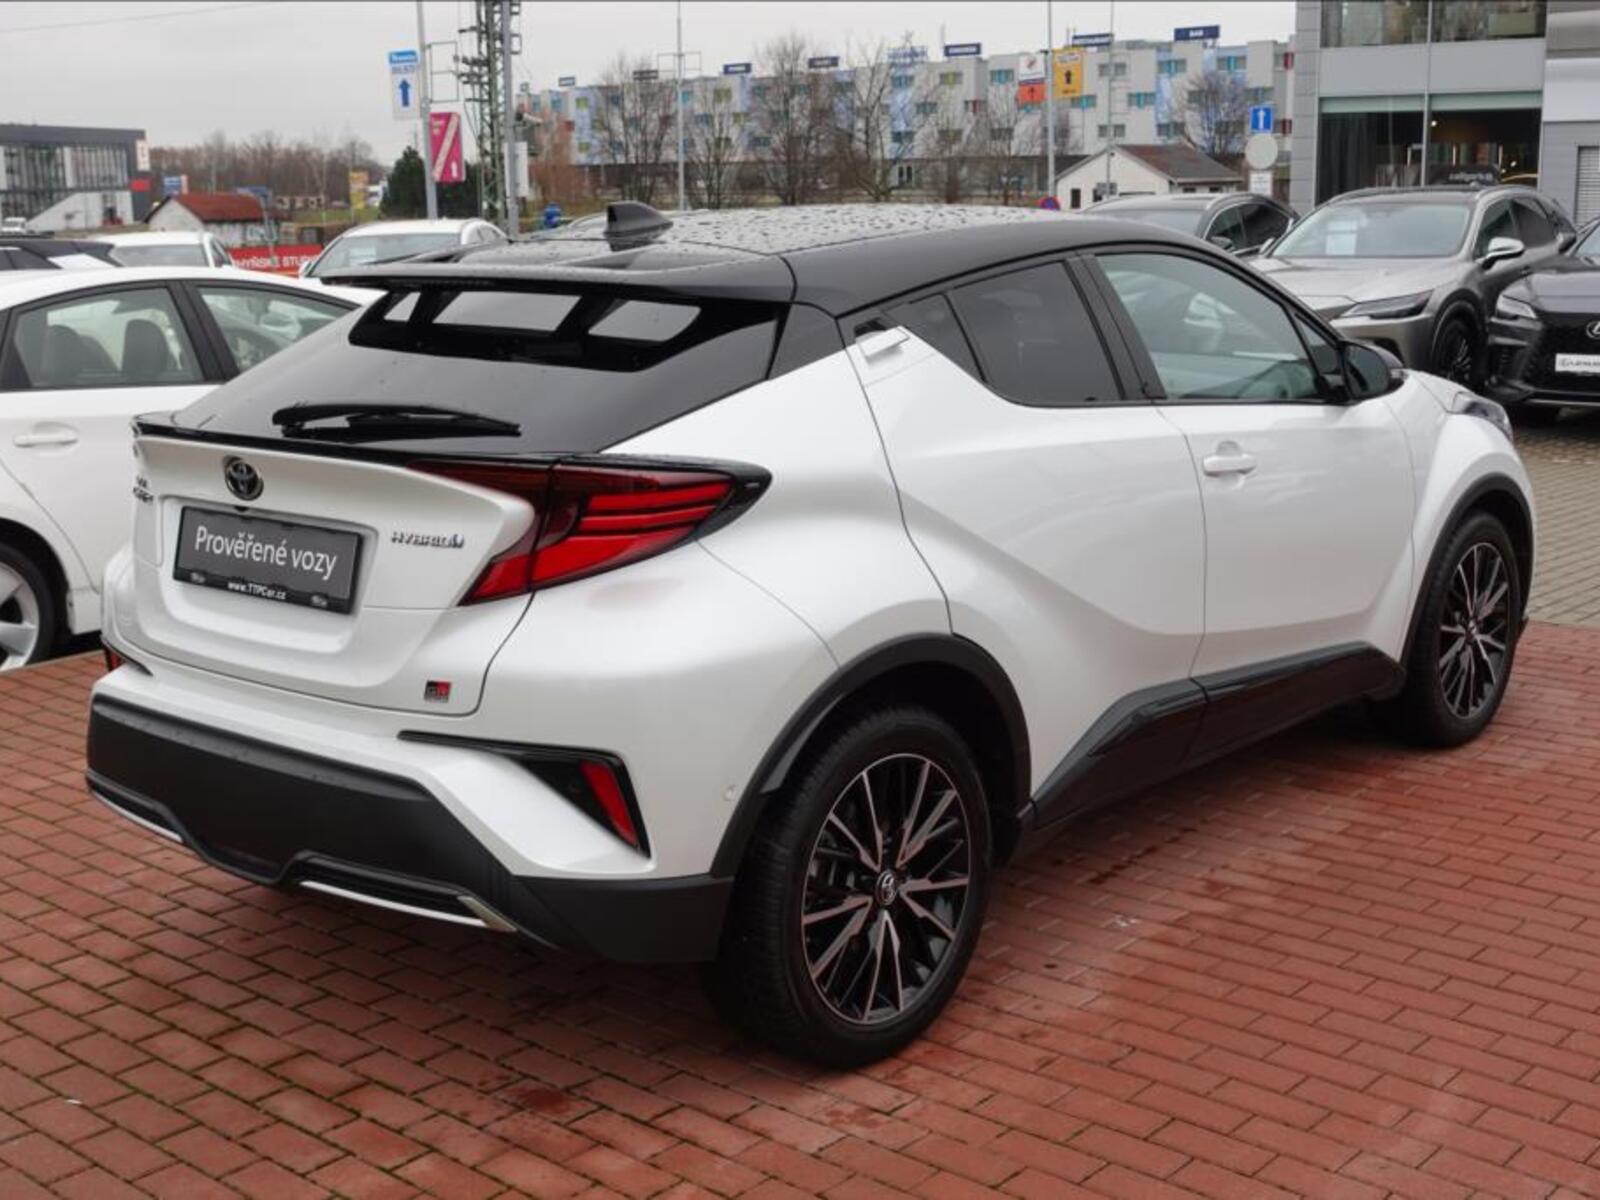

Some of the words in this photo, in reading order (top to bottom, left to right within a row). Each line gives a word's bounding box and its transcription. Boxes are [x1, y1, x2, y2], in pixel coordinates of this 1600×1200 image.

[195, 525, 288, 566] Prověřené
[291, 547, 337, 581] vozy
[227, 581, 287, 600] www.TTPCar.cz
